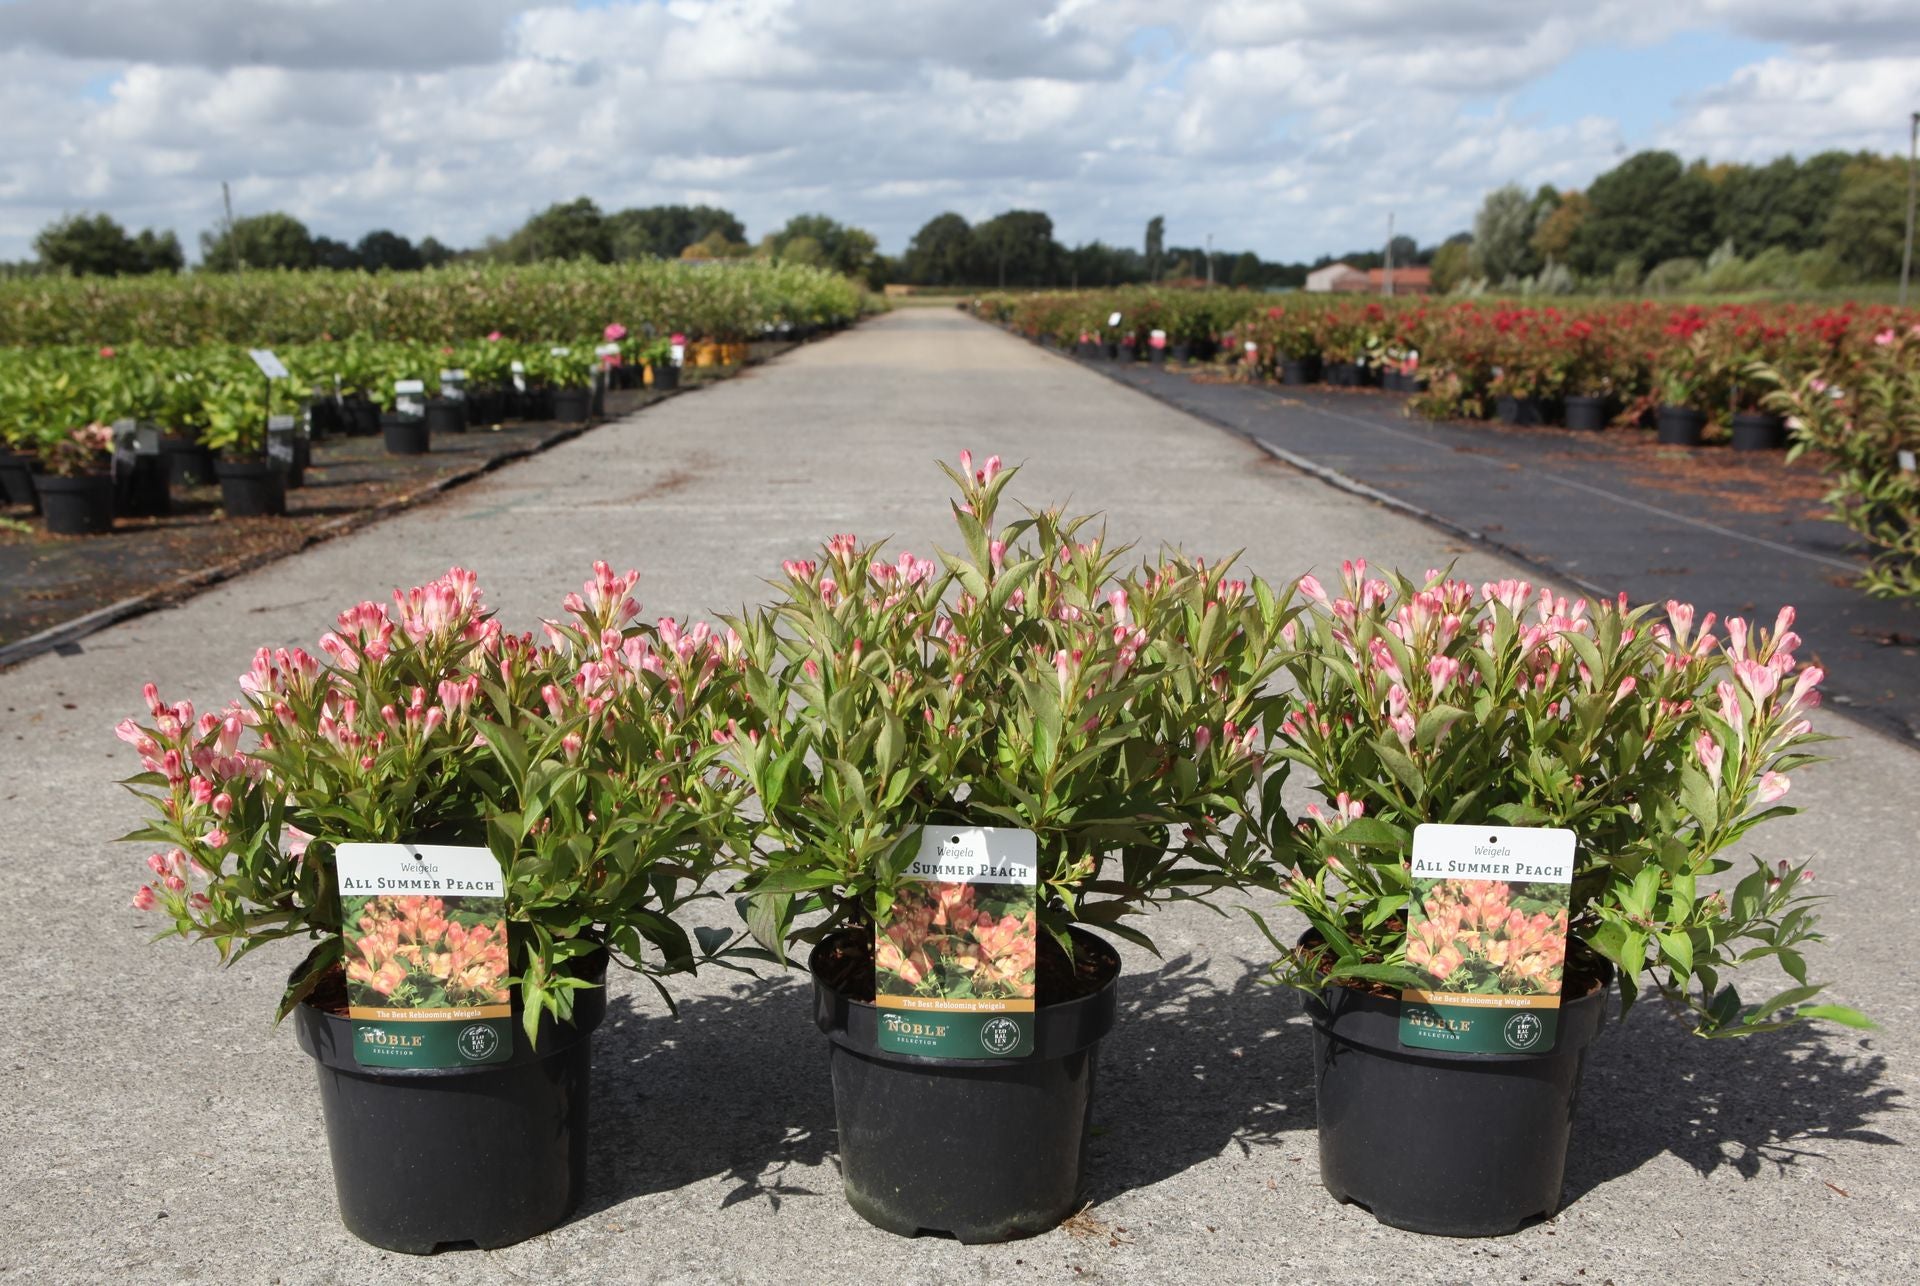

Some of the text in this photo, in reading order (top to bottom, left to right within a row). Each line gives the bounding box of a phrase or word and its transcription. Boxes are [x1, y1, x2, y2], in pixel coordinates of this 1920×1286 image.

[937, 847, 973, 858] Weigela
[1475, 846, 1511, 857] Weigela
[401, 863, 438, 873] Weigela
[913, 862, 974, 875] SUMMER
[981, 865, 1027, 877] PEACH
[1416, 859, 1562, 876] ALL SUMMER PEACH
[344, 878, 494, 890] ALL SUMMER PEACH
[918, 1000, 932, 1008] Best
[935, 1001, 976, 1010] Reblooming
[979, 1002, 1005, 1011] Weigela
[1462, 996, 1502, 1006] Reblooming
[1505, 998, 1530, 1006] Weigela
[409, 1011, 451, 1019] Reblooming
[454, 1010, 481, 1018] Weigela
[888, 1022, 945, 1036] NOBLE
[1410, 1015, 1470, 1032] NOBLE
[363, 1033, 422, 1046] NOBLE
[897, 1037, 936, 1045] SELECTION
[1419, 1032, 1460, 1040] SELECTION
